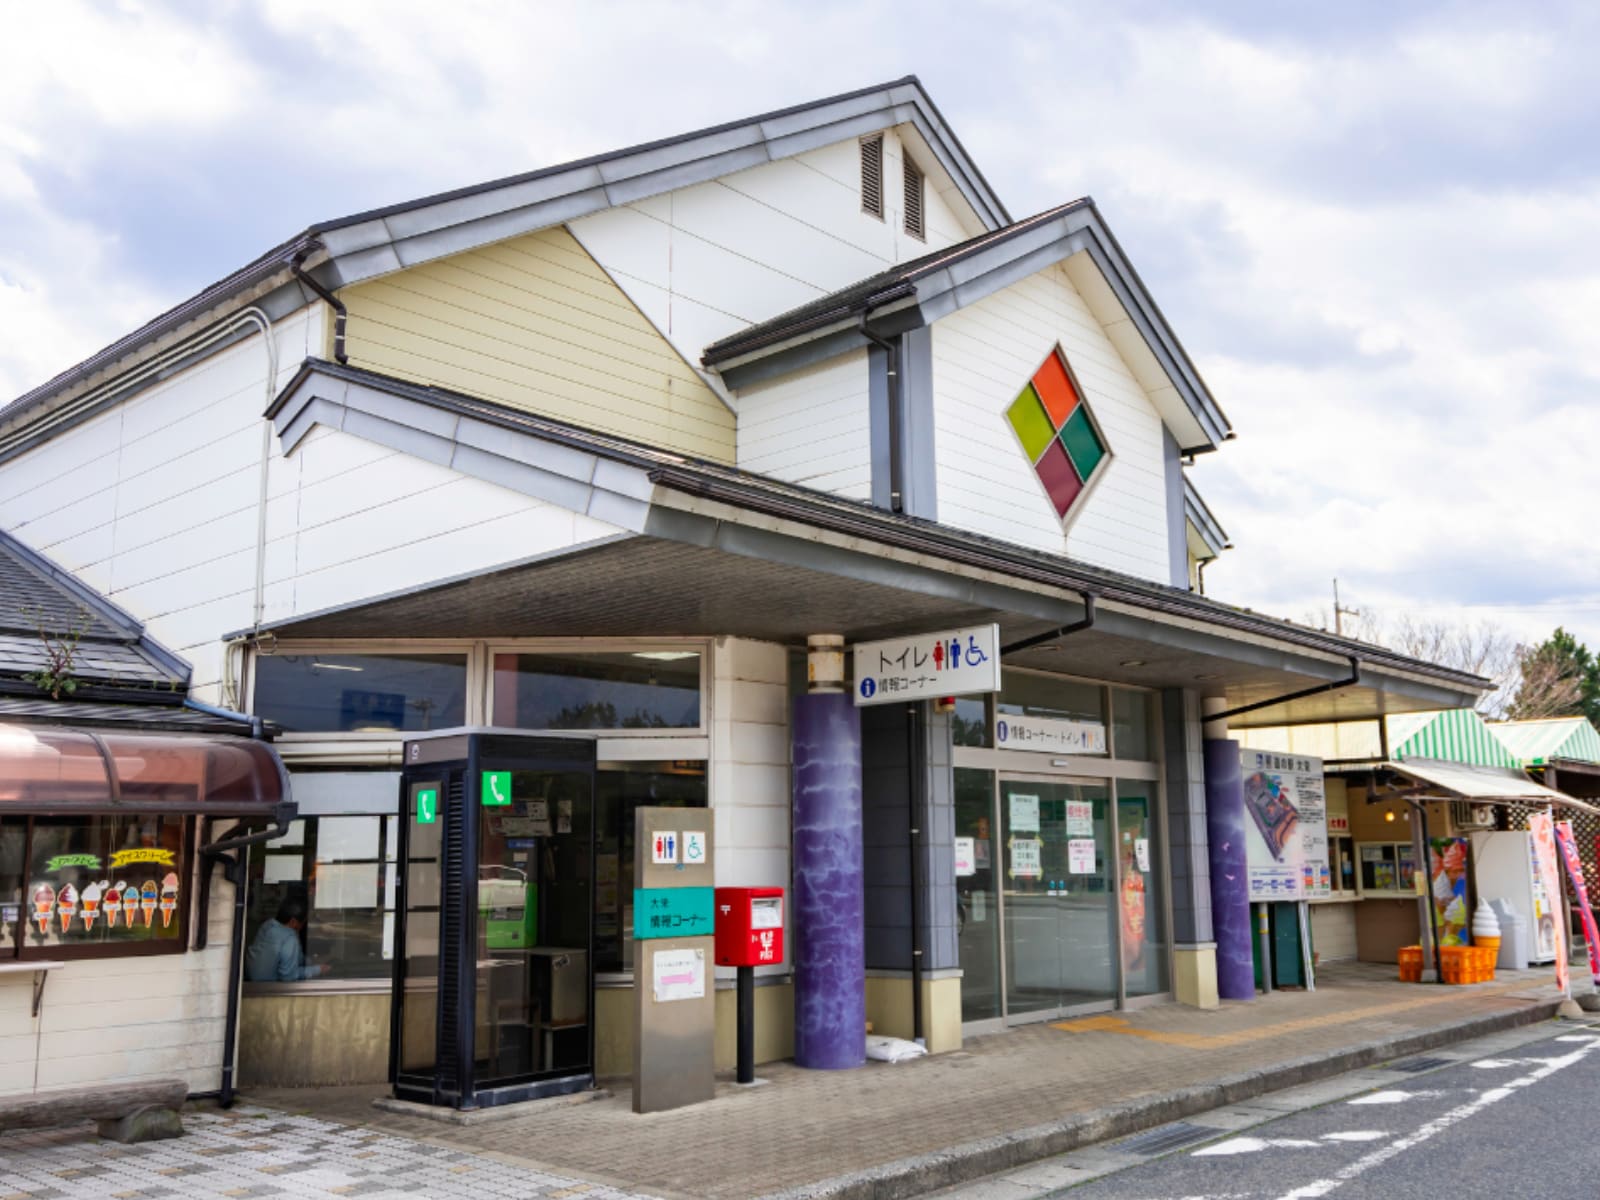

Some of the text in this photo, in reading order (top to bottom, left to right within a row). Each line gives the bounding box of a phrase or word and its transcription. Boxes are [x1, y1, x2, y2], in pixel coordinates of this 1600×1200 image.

[880, 646, 928, 672] トイレ
[878, 675, 937, 693] 情報コーナー
[650, 914, 707, 928] 情報コーナー
